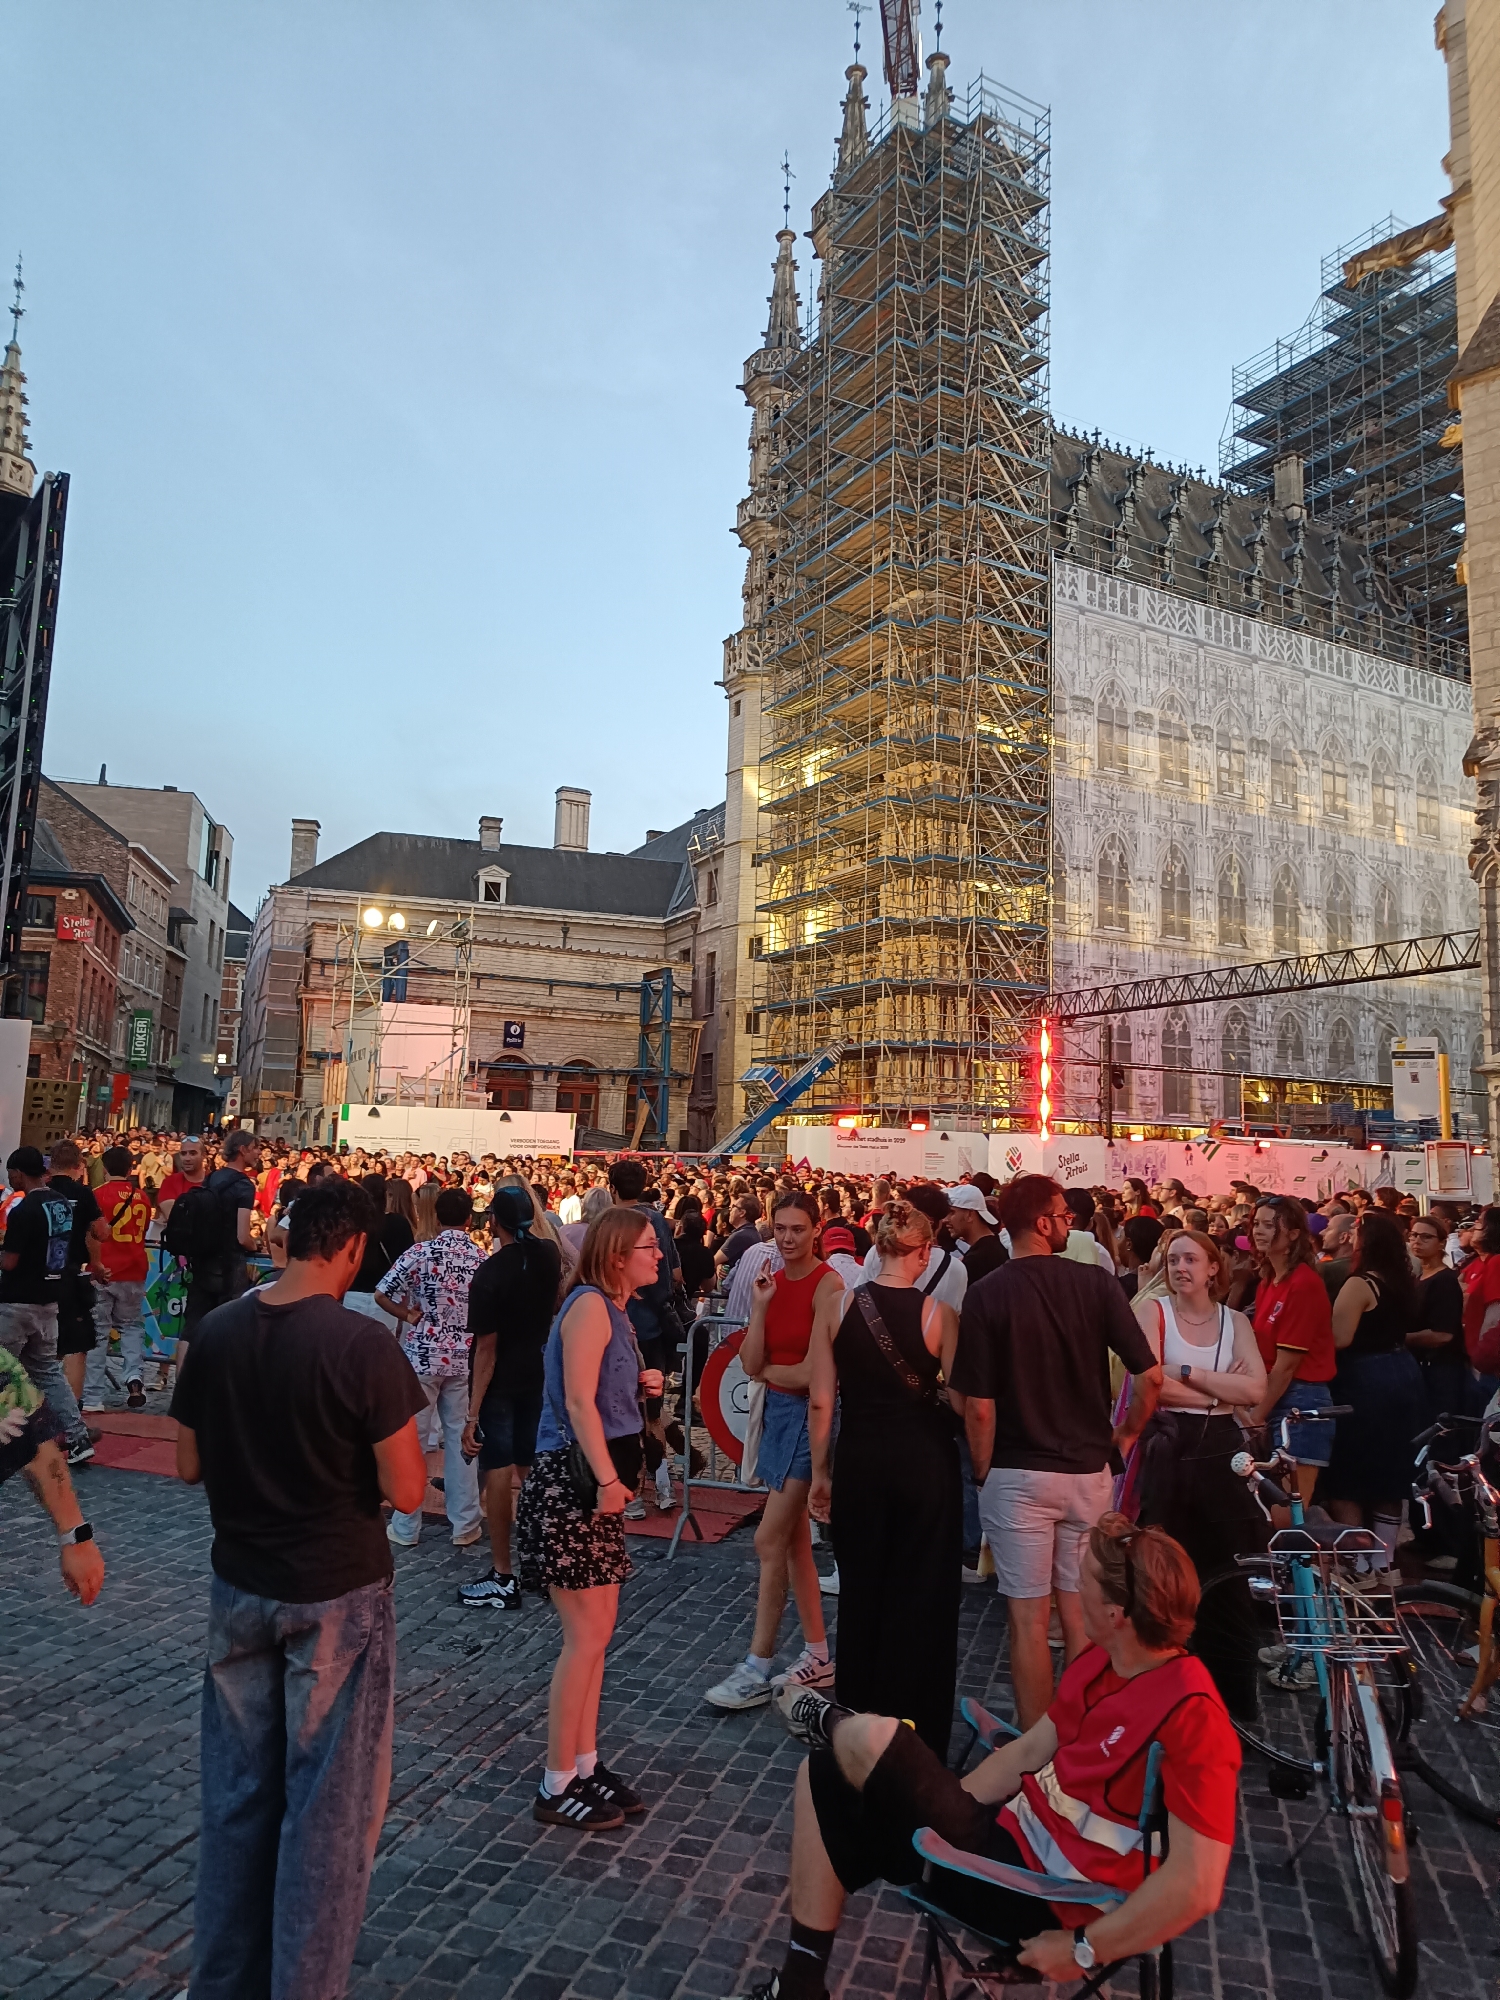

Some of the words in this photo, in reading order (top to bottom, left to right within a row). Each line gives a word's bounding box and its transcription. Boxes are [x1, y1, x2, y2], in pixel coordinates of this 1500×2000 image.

[135, 1020, 148, 1054] JOKER
[1058, 1153, 1080, 1168] Stella
[1065, 1162, 1088, 1180] Artois
[113, 1202, 146, 1243] 23
